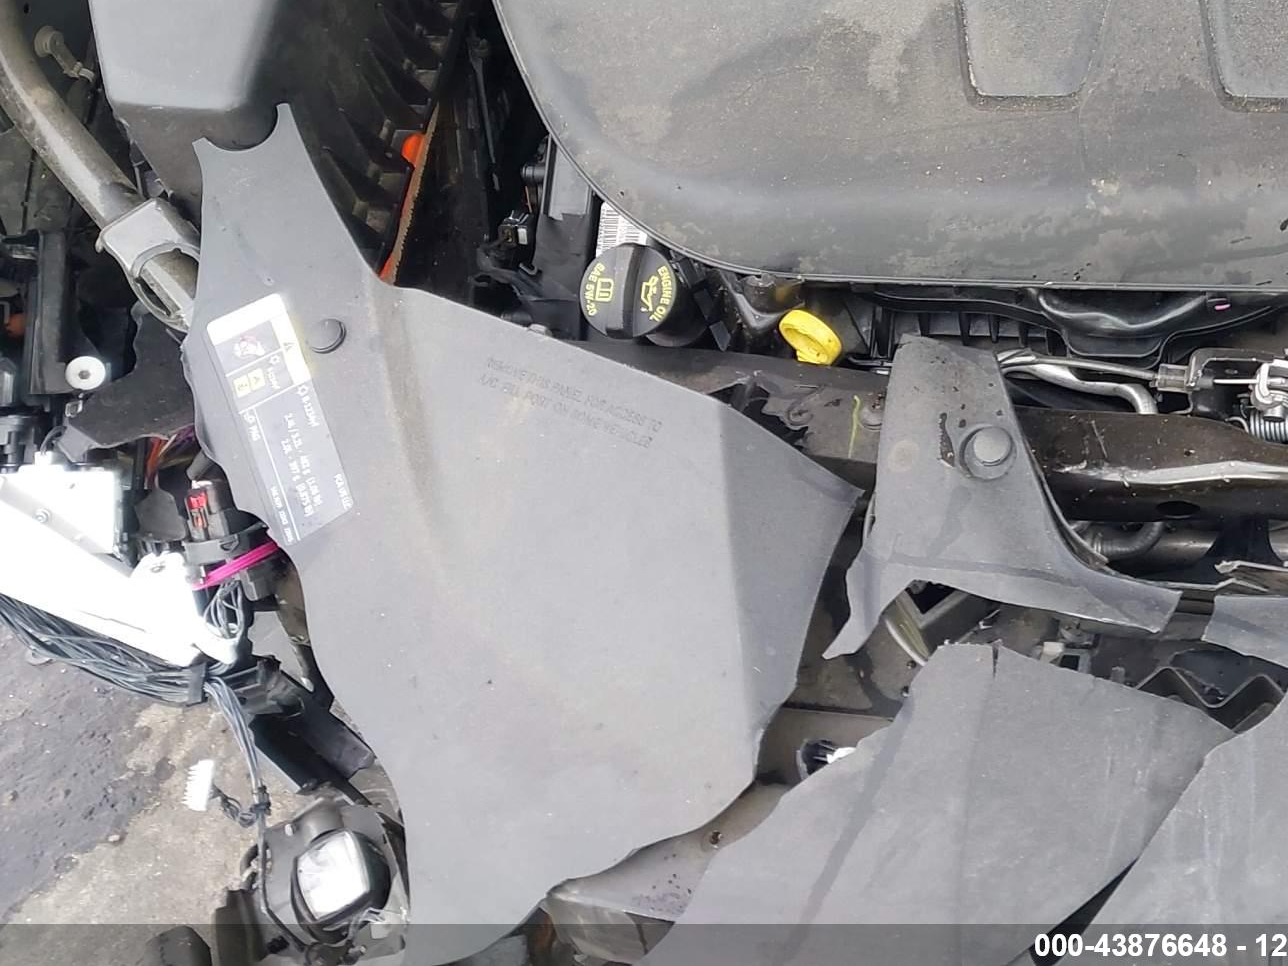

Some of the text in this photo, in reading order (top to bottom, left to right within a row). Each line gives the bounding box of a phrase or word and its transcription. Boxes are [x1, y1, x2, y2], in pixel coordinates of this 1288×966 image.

[584, 262, 605, 316] SAE 5W-20
[648, 265, 673, 323] ENGINE OIL
[249, 425, 261, 441] PAG
